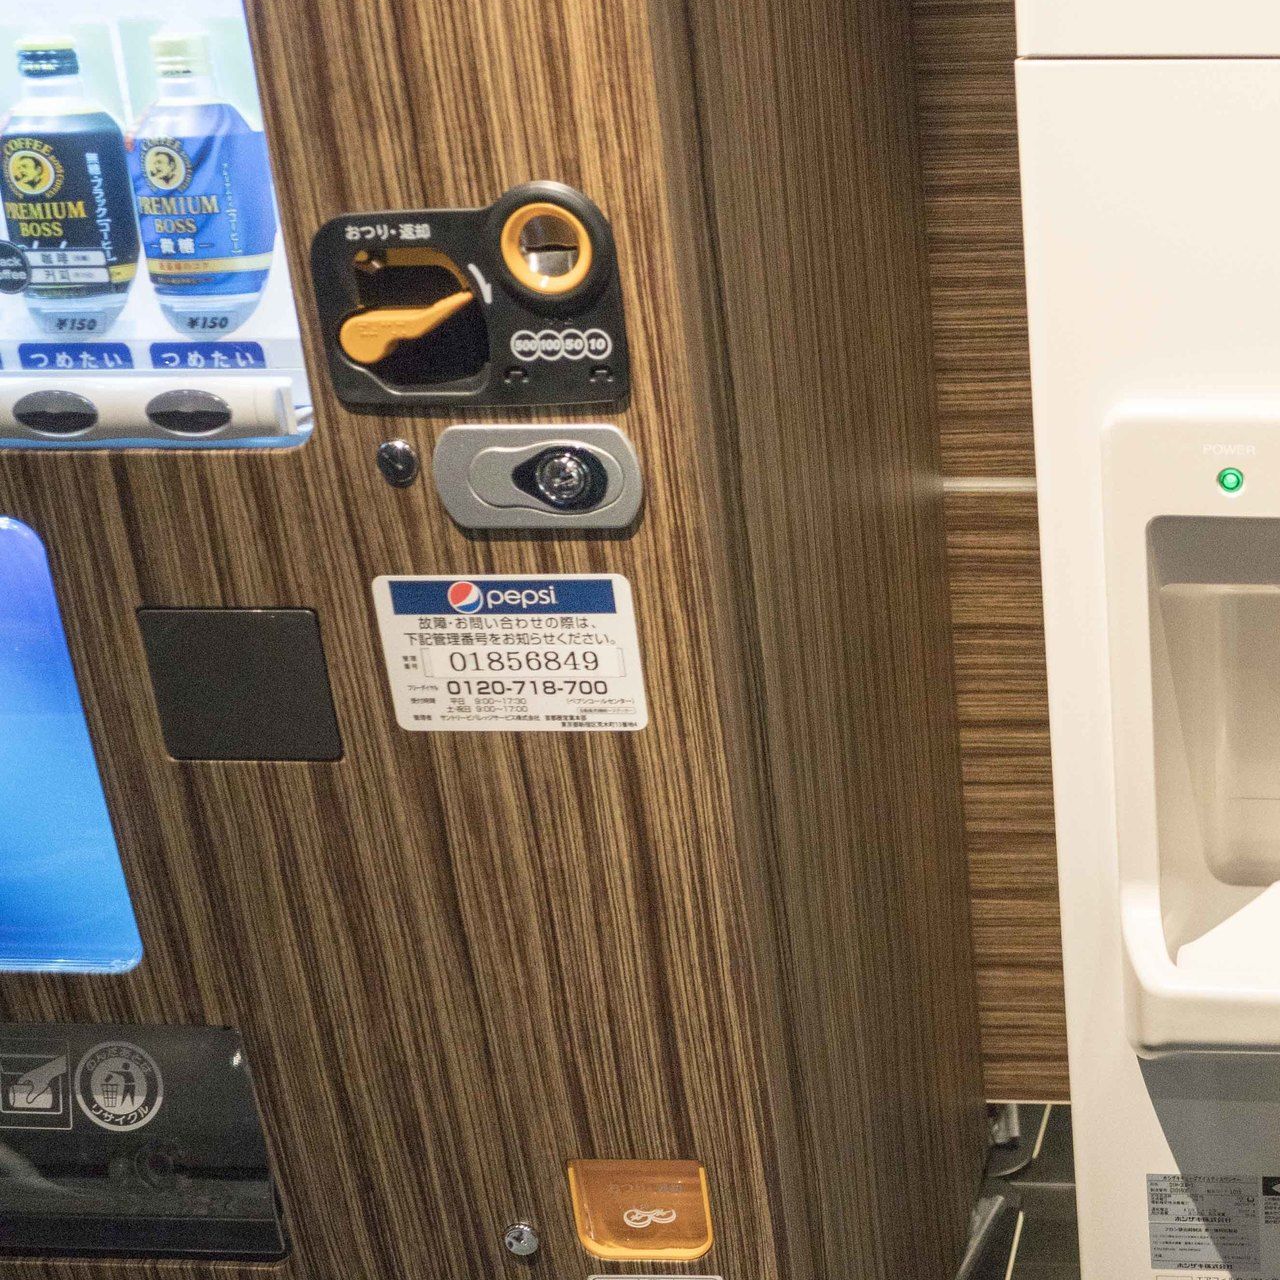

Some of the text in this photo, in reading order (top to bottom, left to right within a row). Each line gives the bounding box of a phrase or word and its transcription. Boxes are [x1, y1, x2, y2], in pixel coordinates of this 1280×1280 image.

[19, 222, 64, 237] BOSS
[154, 218, 197, 234] BOSS
[56, 319, 97, 331] ¥150
[188, 316, 229, 330] ¥150
[514, 337, 606, 351] 500 100 50 10
[30, 351, 123, 368] つめたい
[161, 351, 255, 368] つめたい
[1203, 444, 1256, 456] POWER
[487, 586, 558, 609] pepsi
[405, 632, 617, 646] 下記管理番号をお知らせください。
[449, 650, 600, 672] 01856849
[446, 680, 609, 695] 0120-718-700
[91, 1103, 149, 1125] リサイクル
